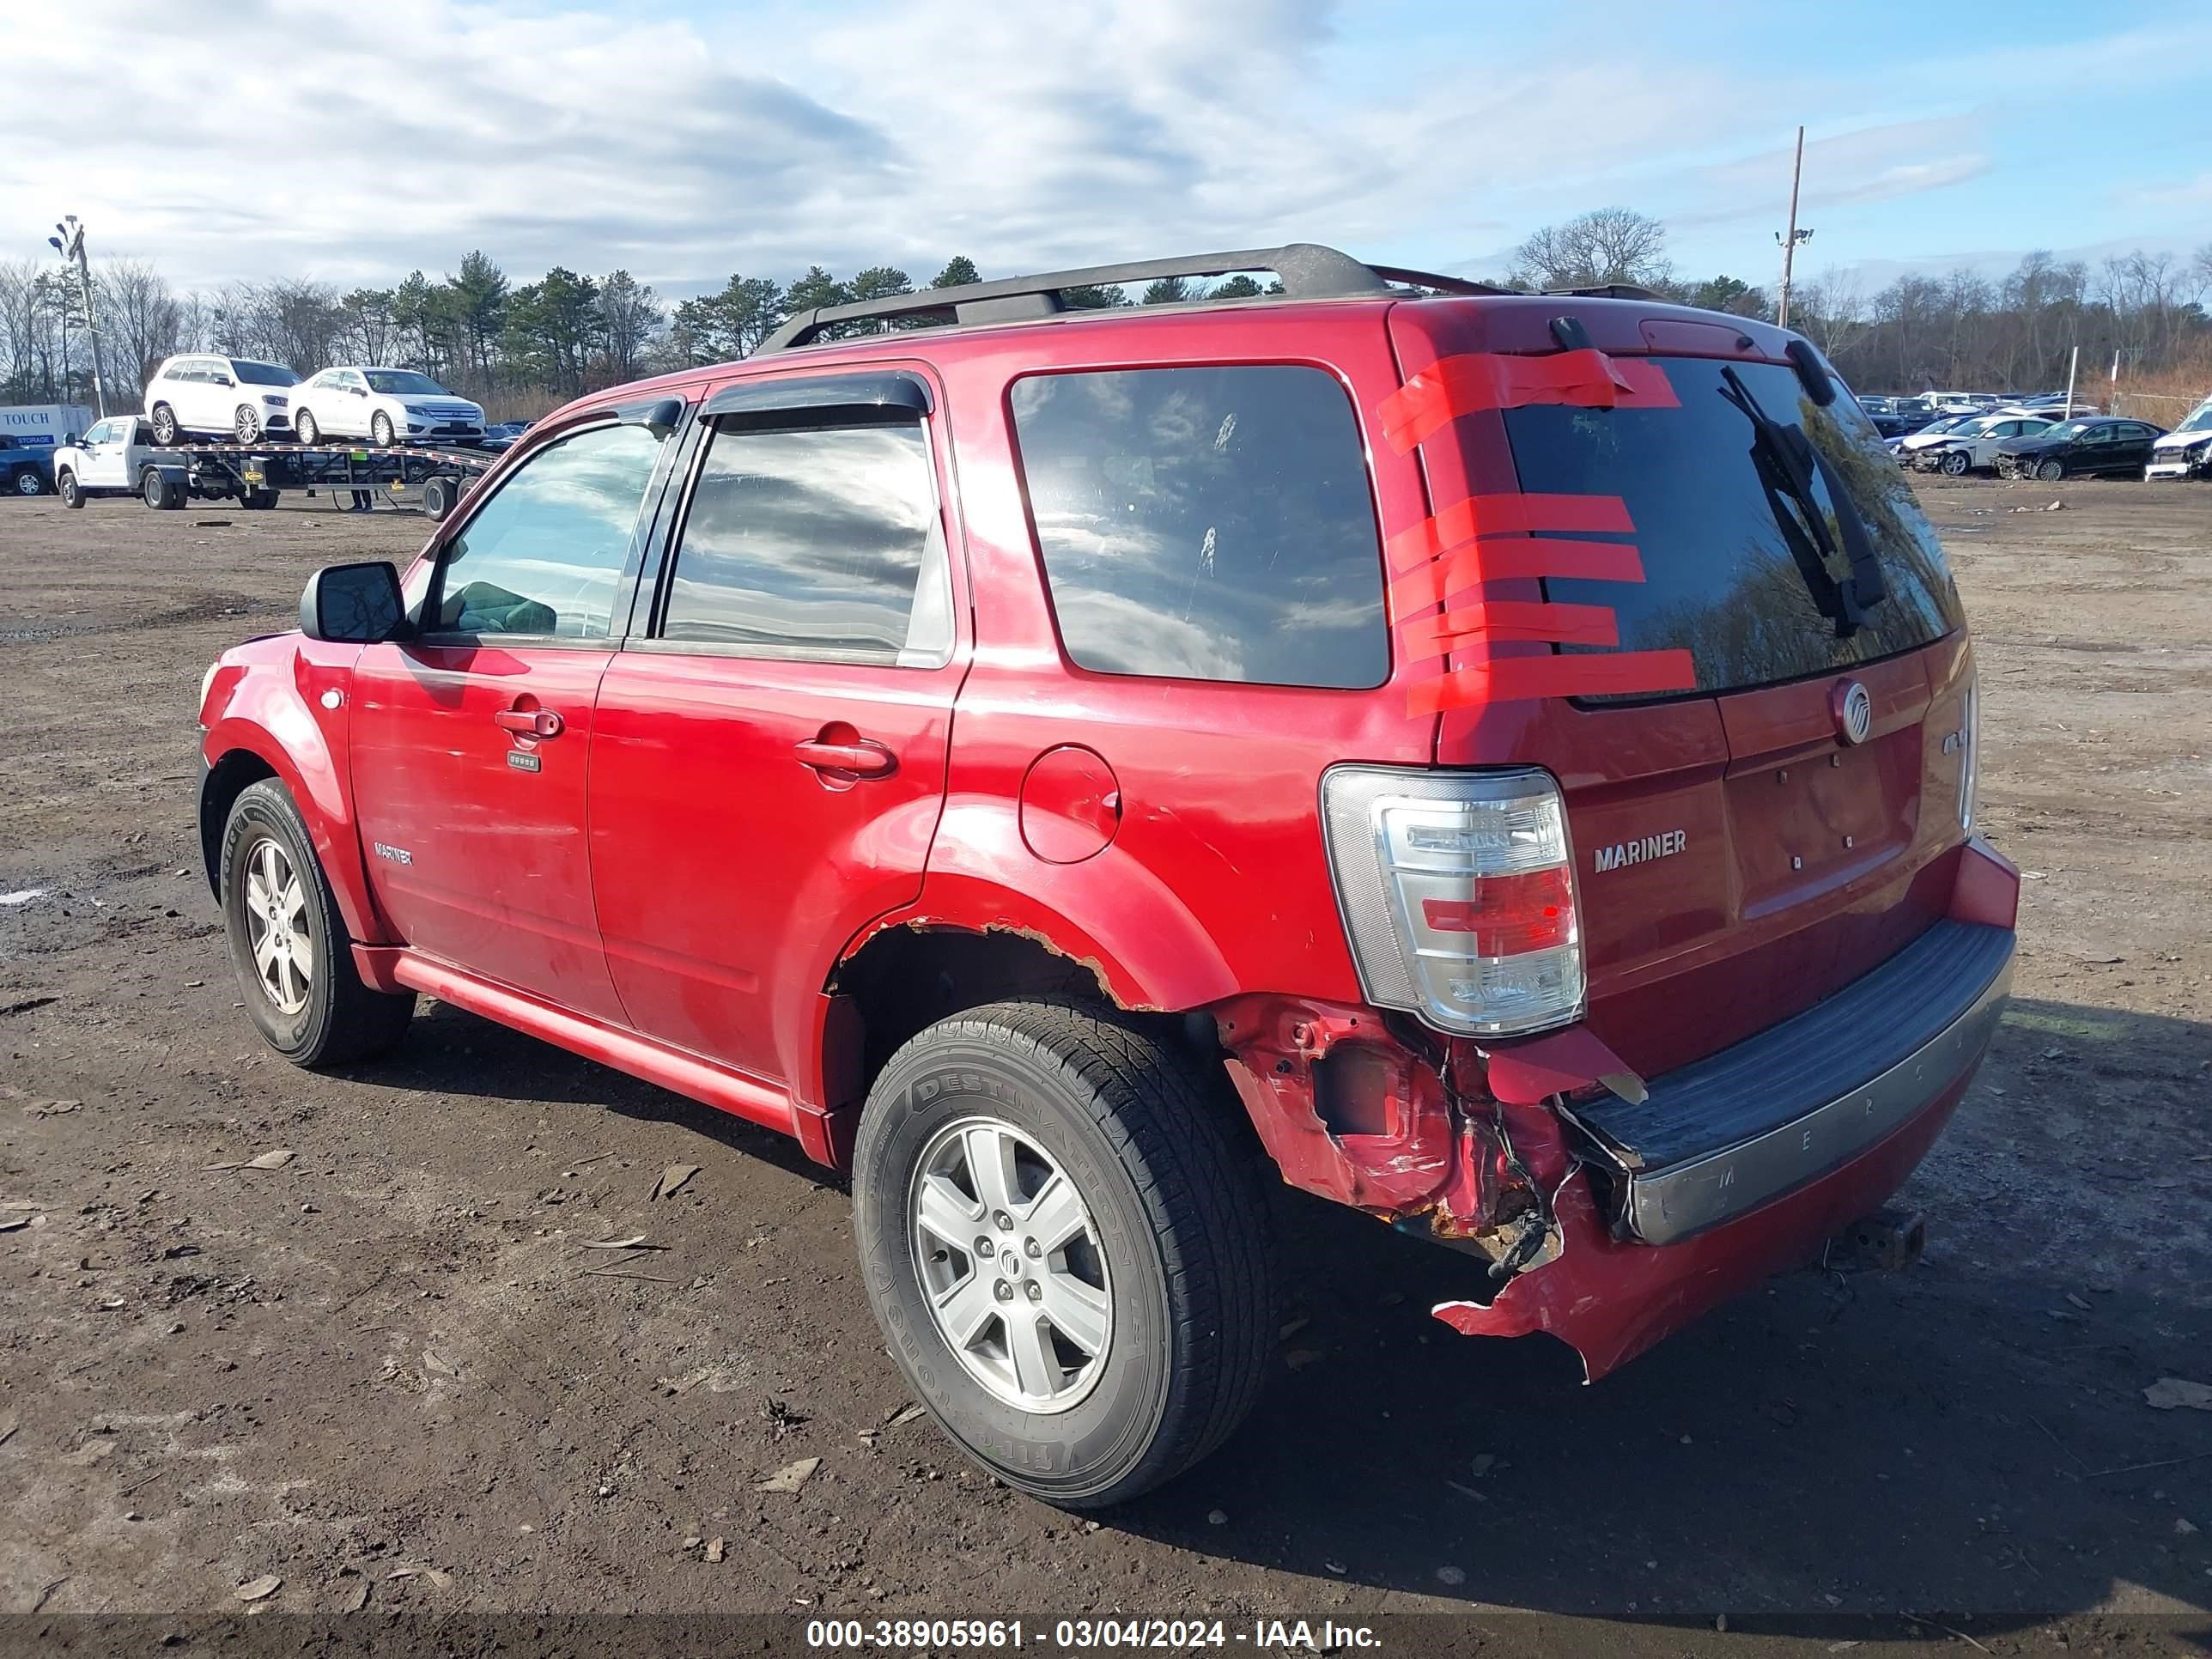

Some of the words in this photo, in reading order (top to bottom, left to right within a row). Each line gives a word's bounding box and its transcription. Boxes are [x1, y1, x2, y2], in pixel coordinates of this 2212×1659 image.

[3, 412, 49, 426] TOUCH
[374, 842, 413, 866] MARINER
[1595, 830, 1686, 873] MARINER
[915, 1073, 1133, 1268] DESTINATION
